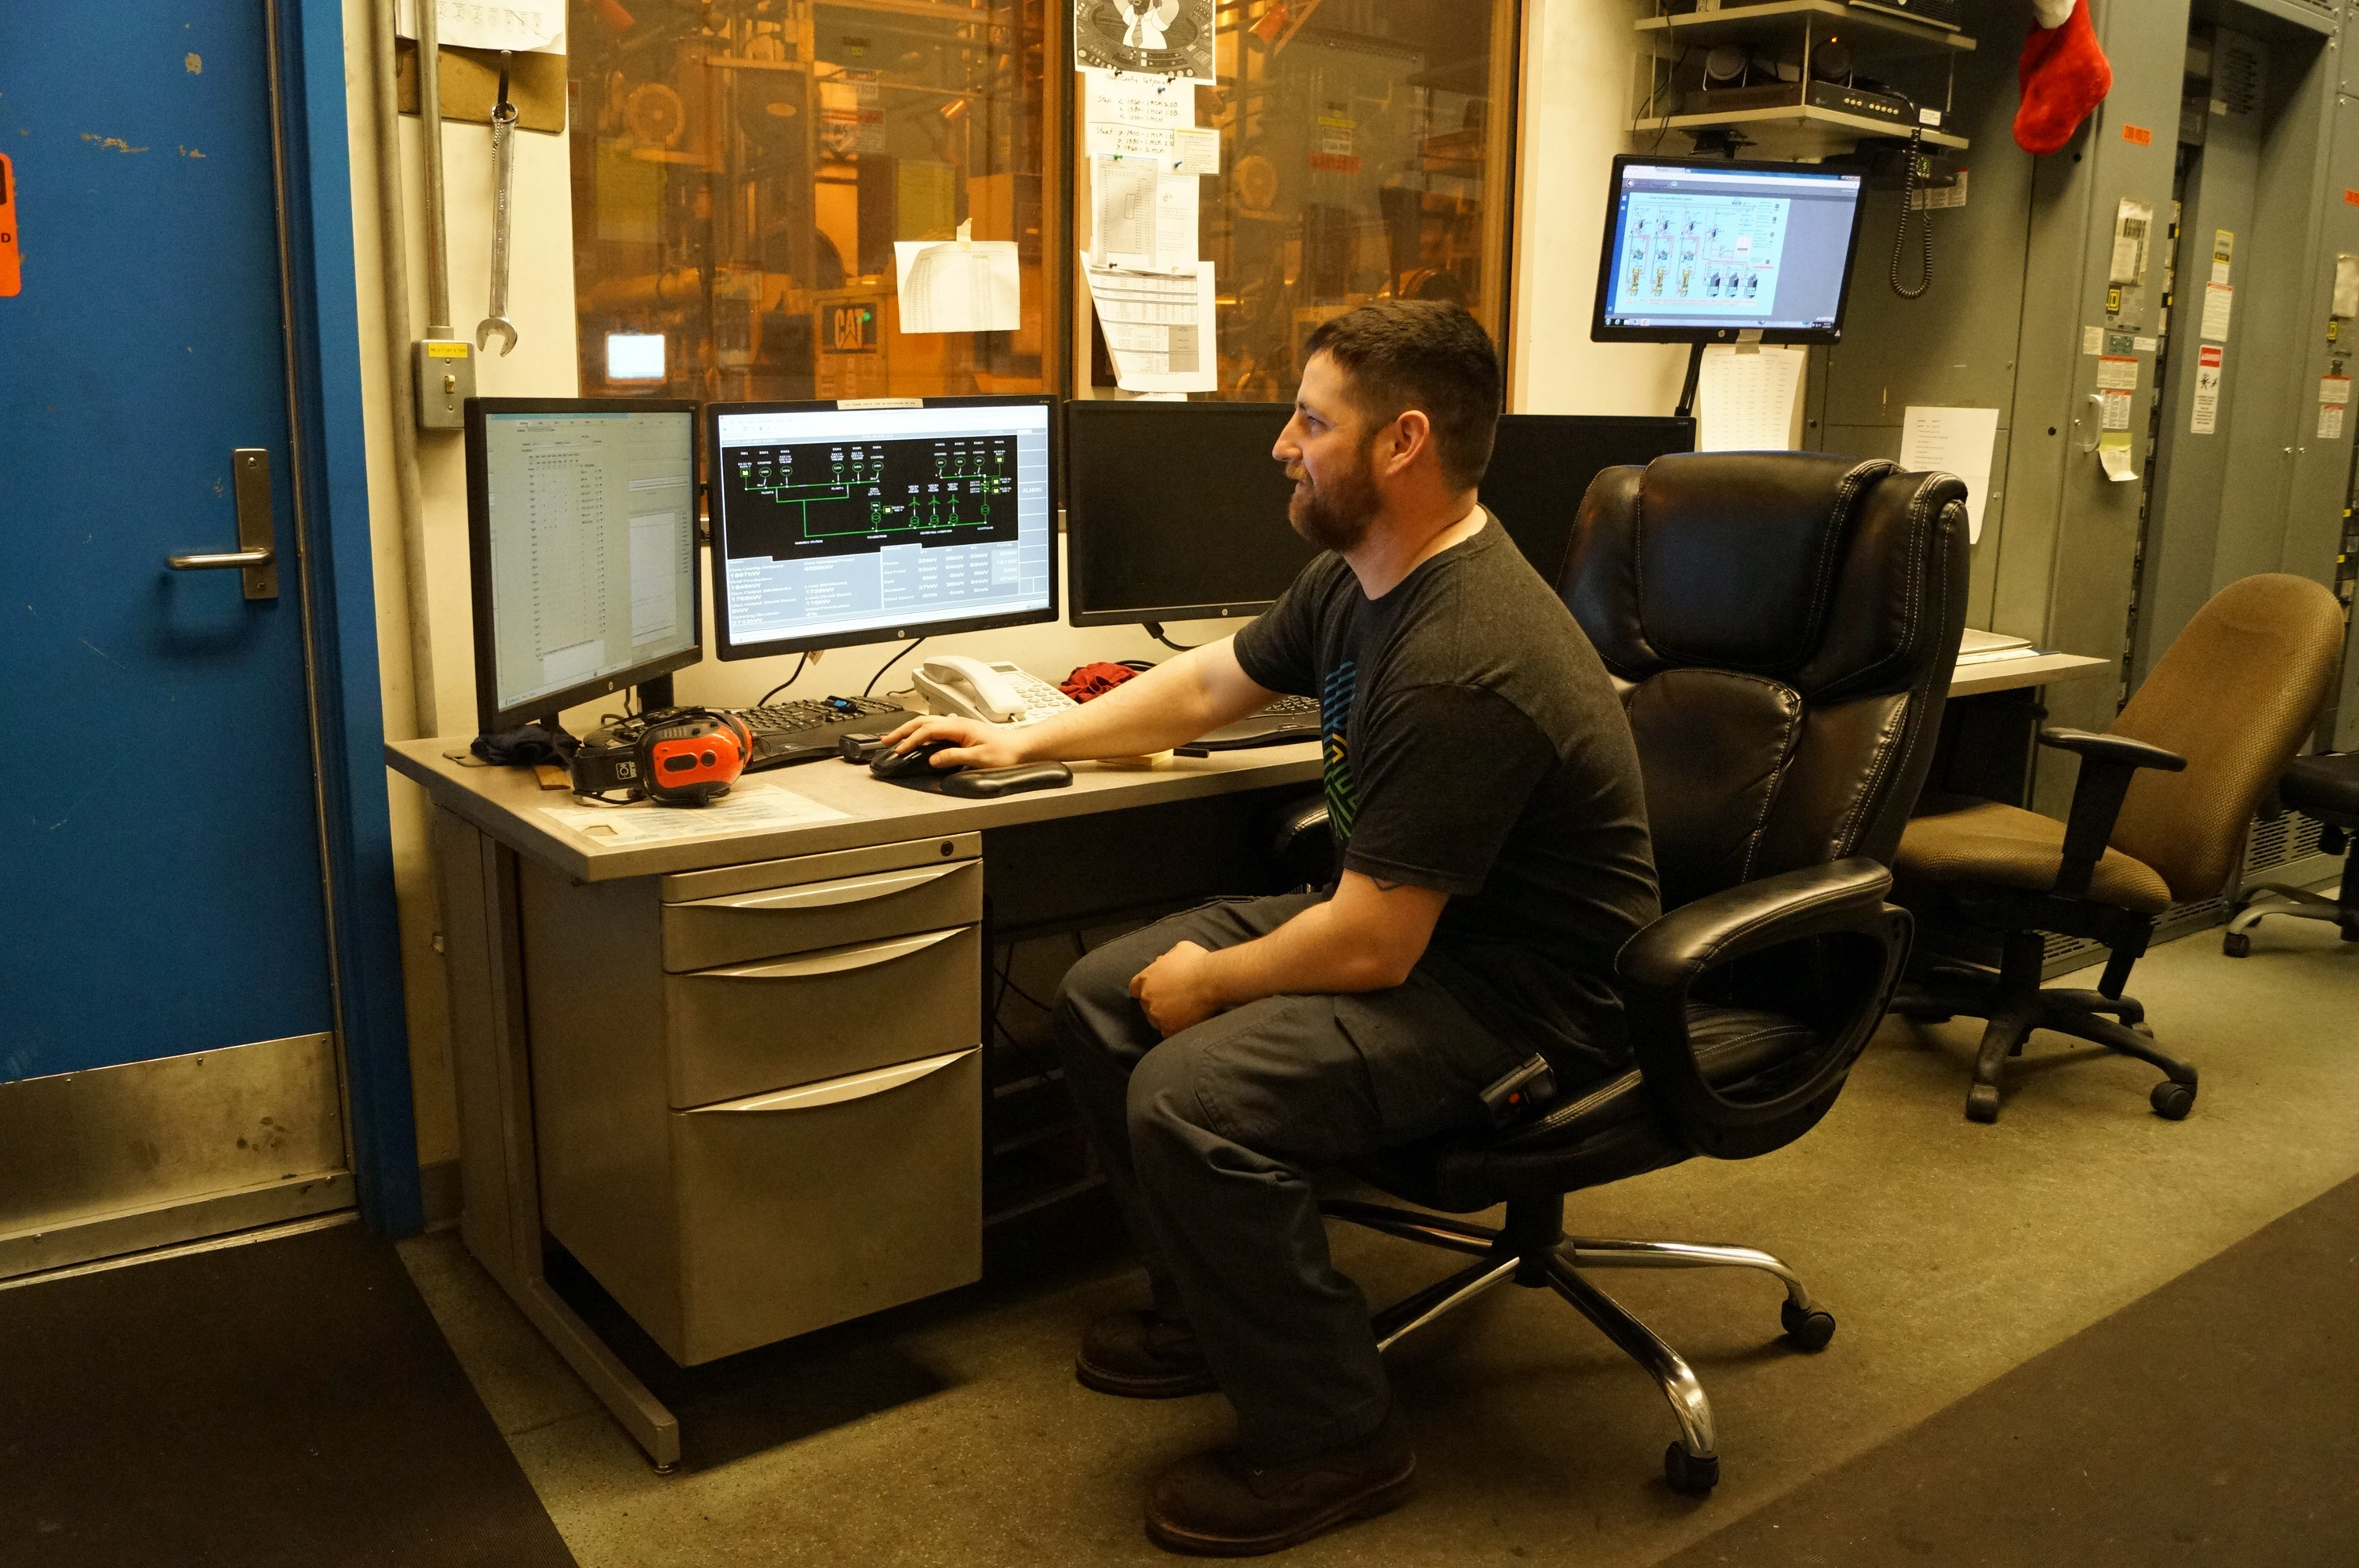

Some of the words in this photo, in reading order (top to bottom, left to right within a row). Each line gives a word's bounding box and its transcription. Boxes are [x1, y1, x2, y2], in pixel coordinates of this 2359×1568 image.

[1098, 95, 1111, 104] Stop
[1096, 125, 1113, 135] Start
[834, 308, 865, 350] CAT
